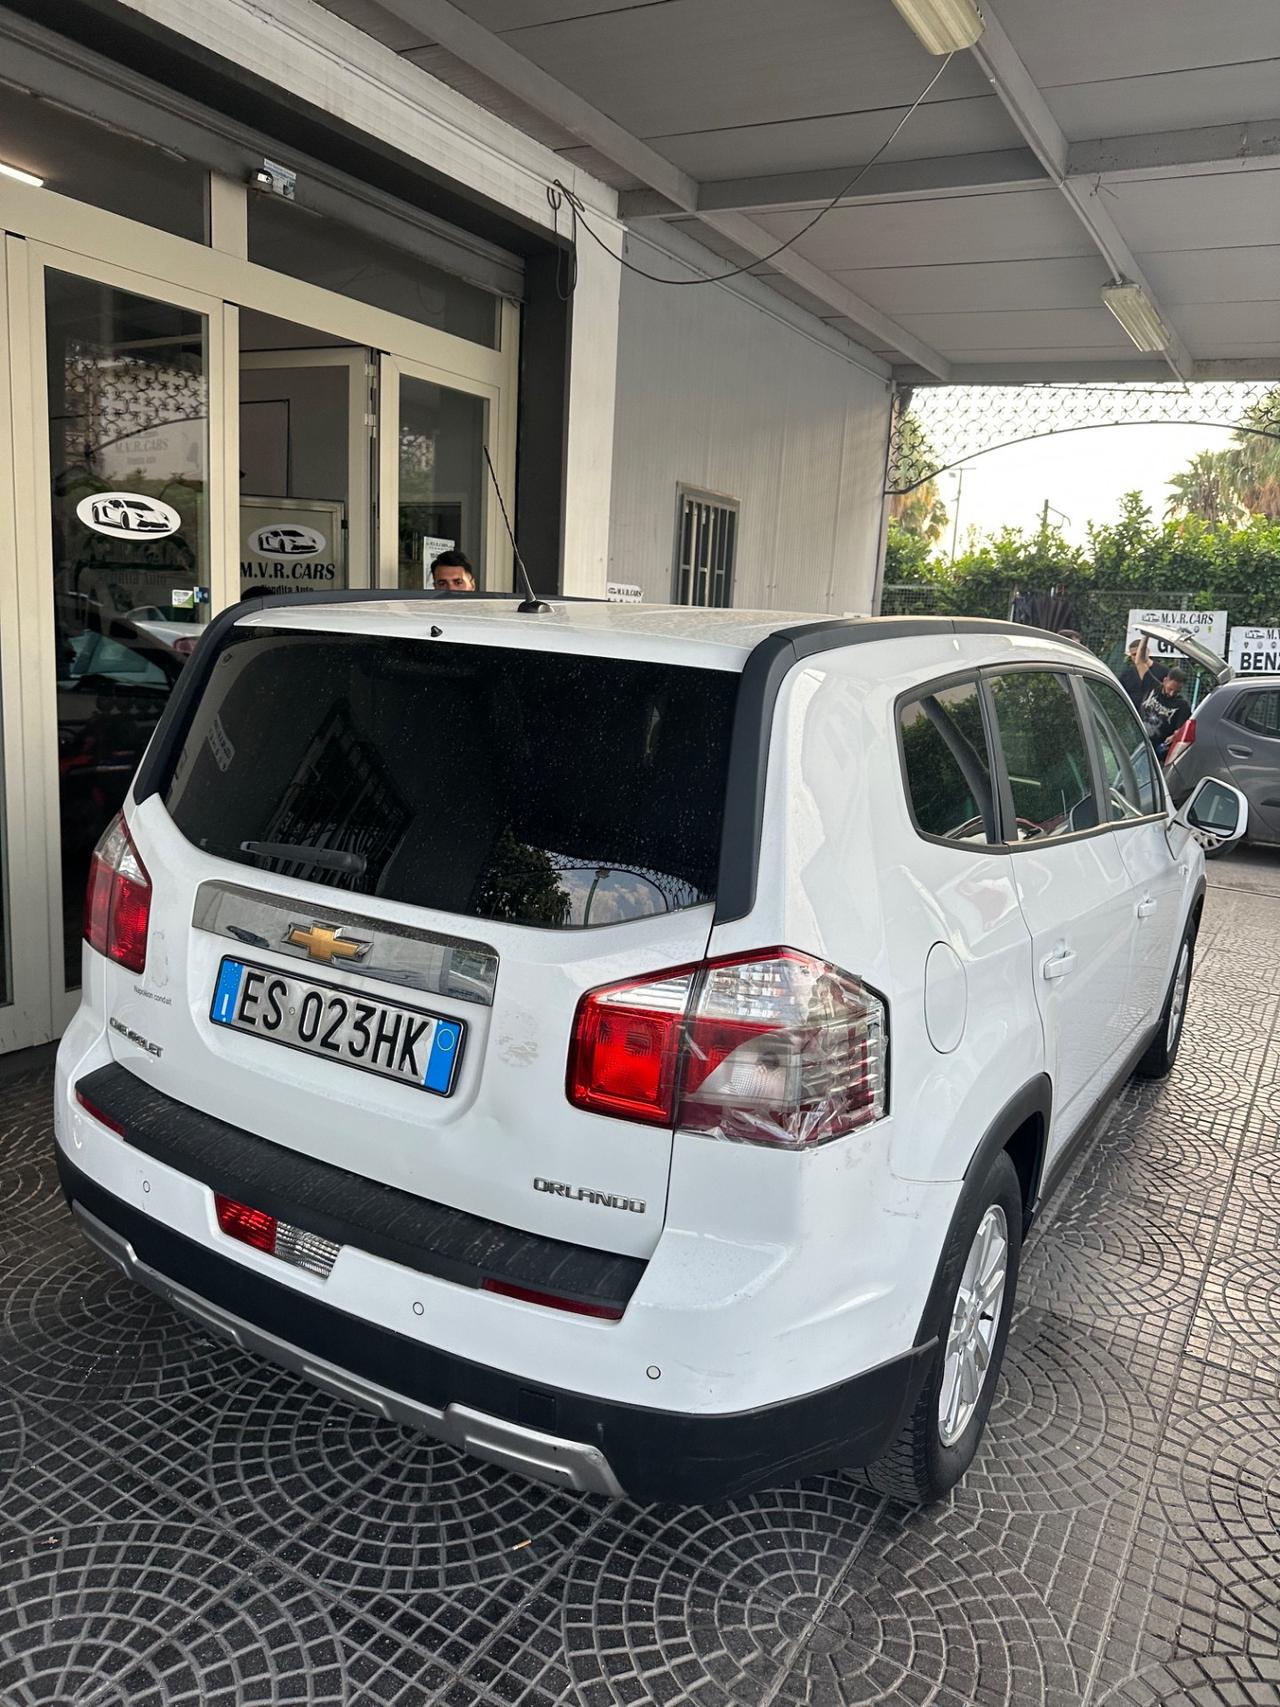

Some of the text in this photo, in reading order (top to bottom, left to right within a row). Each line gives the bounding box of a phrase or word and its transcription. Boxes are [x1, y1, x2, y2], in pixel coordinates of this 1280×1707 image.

[240, 561, 337, 580] M.V.R.CARS
[1161, 612, 1214, 625] M.V.R.CARS
[1240, 652, 1280, 671] BEN
[238, 970, 288, 1031] ES
[298, 990, 429, 1077] 023HK
[533, 1176, 647, 1214] ORLANDO
